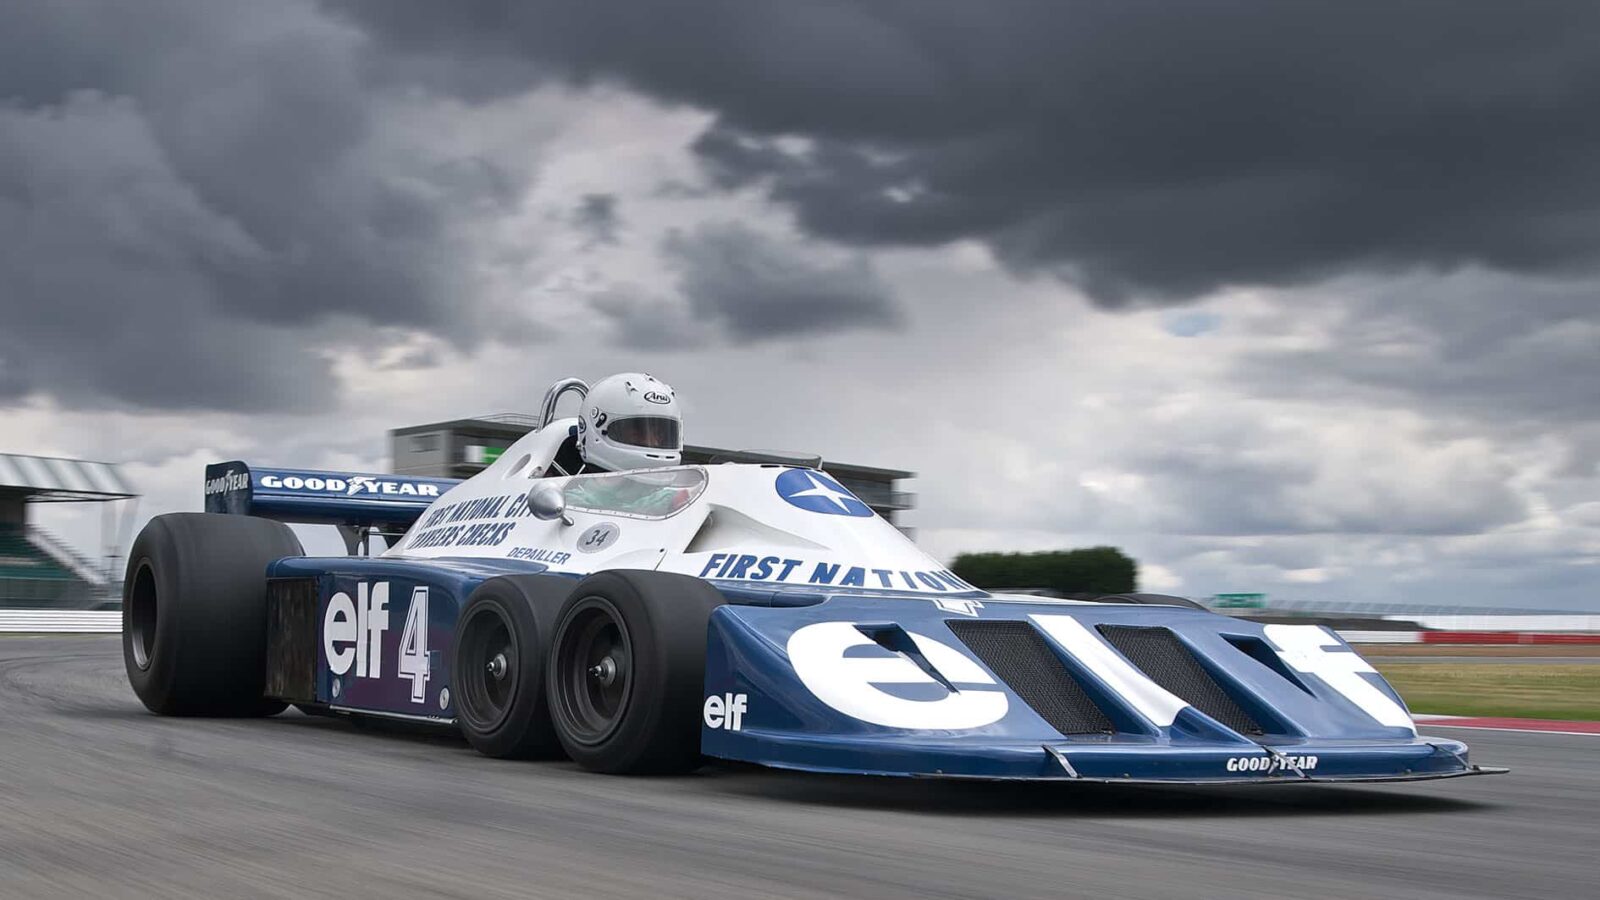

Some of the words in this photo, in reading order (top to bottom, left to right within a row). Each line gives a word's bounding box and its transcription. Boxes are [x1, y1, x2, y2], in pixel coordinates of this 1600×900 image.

[446, 495, 511, 523] NATIONAL
[455, 522, 517, 547] CHECKS
[586, 529, 611, 547] 34
[506, 547, 572, 565] DEPAILLER
[699, 553, 802, 582] FIRST
[324, 581, 390, 679] elf
[398, 586, 431, 703] 4
[786, 614, 1418, 731] elf
[703, 692, 748, 731] elf
